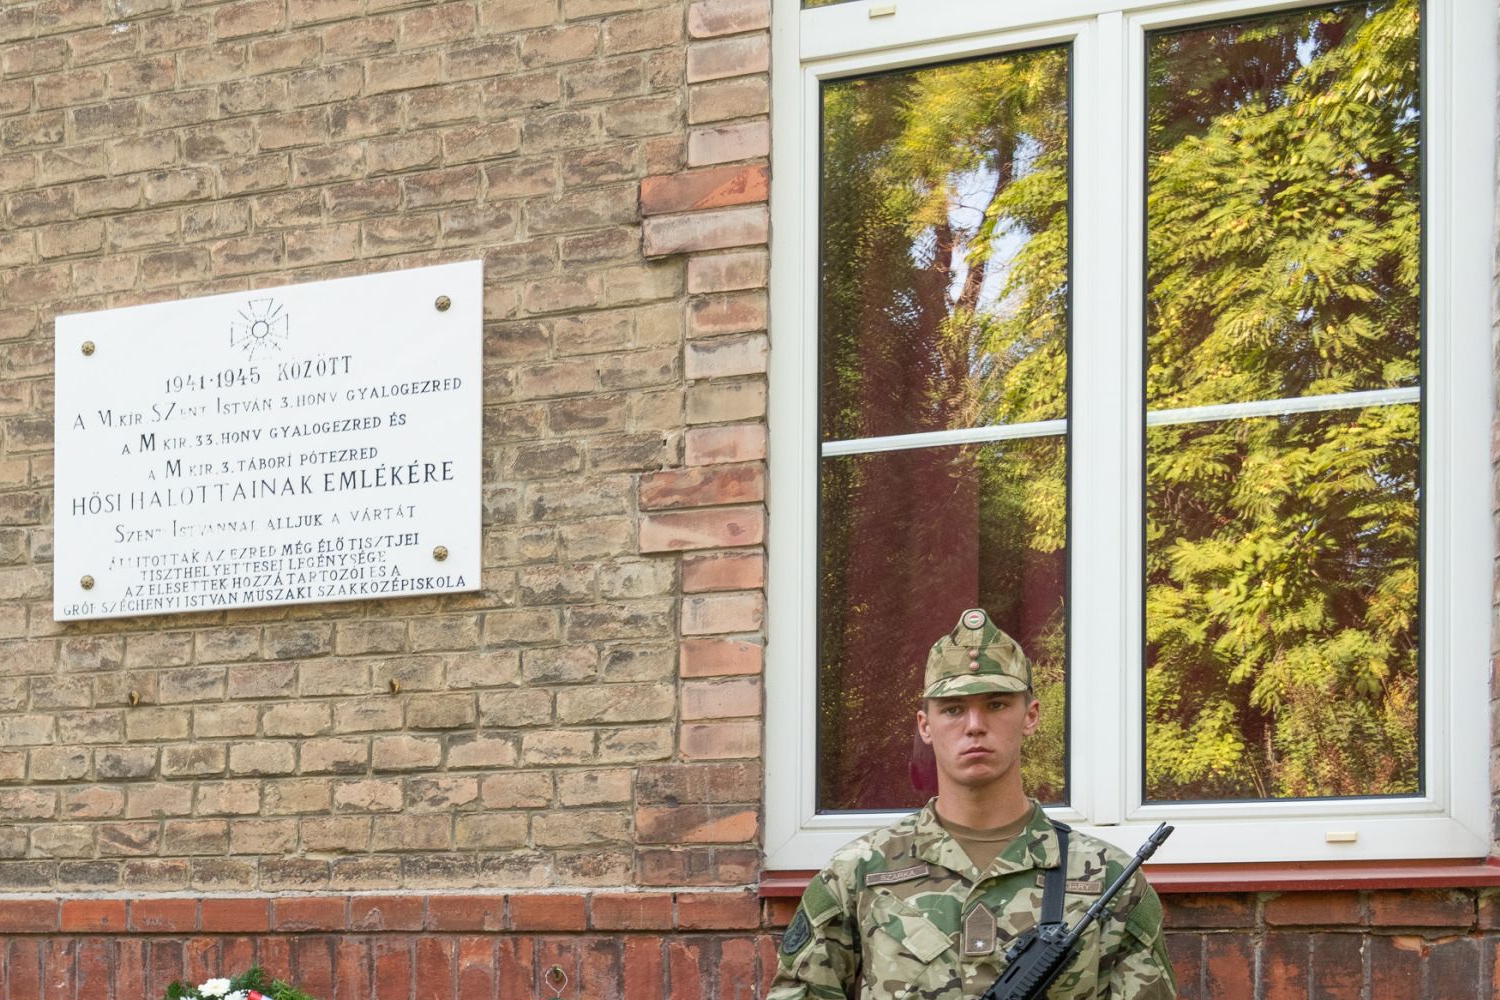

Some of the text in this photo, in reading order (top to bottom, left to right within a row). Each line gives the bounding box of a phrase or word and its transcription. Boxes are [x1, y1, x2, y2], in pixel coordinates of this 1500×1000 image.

[73, 414, 86, 431] A
[347, 377, 462, 402] GYALOGEZRED
[122, 444, 130, 455] A
[270, 416, 381, 439] GYALOGEZRED
[390, 413, 407, 427] ÉS
[149, 470, 156, 481] A
[300, 447, 378, 466] PÓTEZRED
[131, 479, 314, 511] HALOTTAINAK
[324, 461, 455, 493] EMLÉKÉRE
[331, 514, 340, 525] A
[350, 505, 417, 521] VÁRTÁT
[281, 540, 313, 557] MÉG
[318, 535, 344, 553] ÉLŐ
[349, 532, 420, 551] TISZTJEI
[125, 586, 145, 598] AZ
[149, 578, 228, 596] ELESETTEK
[391, 565, 402, 577] A
[141, 550, 386, 582] TISZTHELYETTESEI LEGÉNYSÉGE
